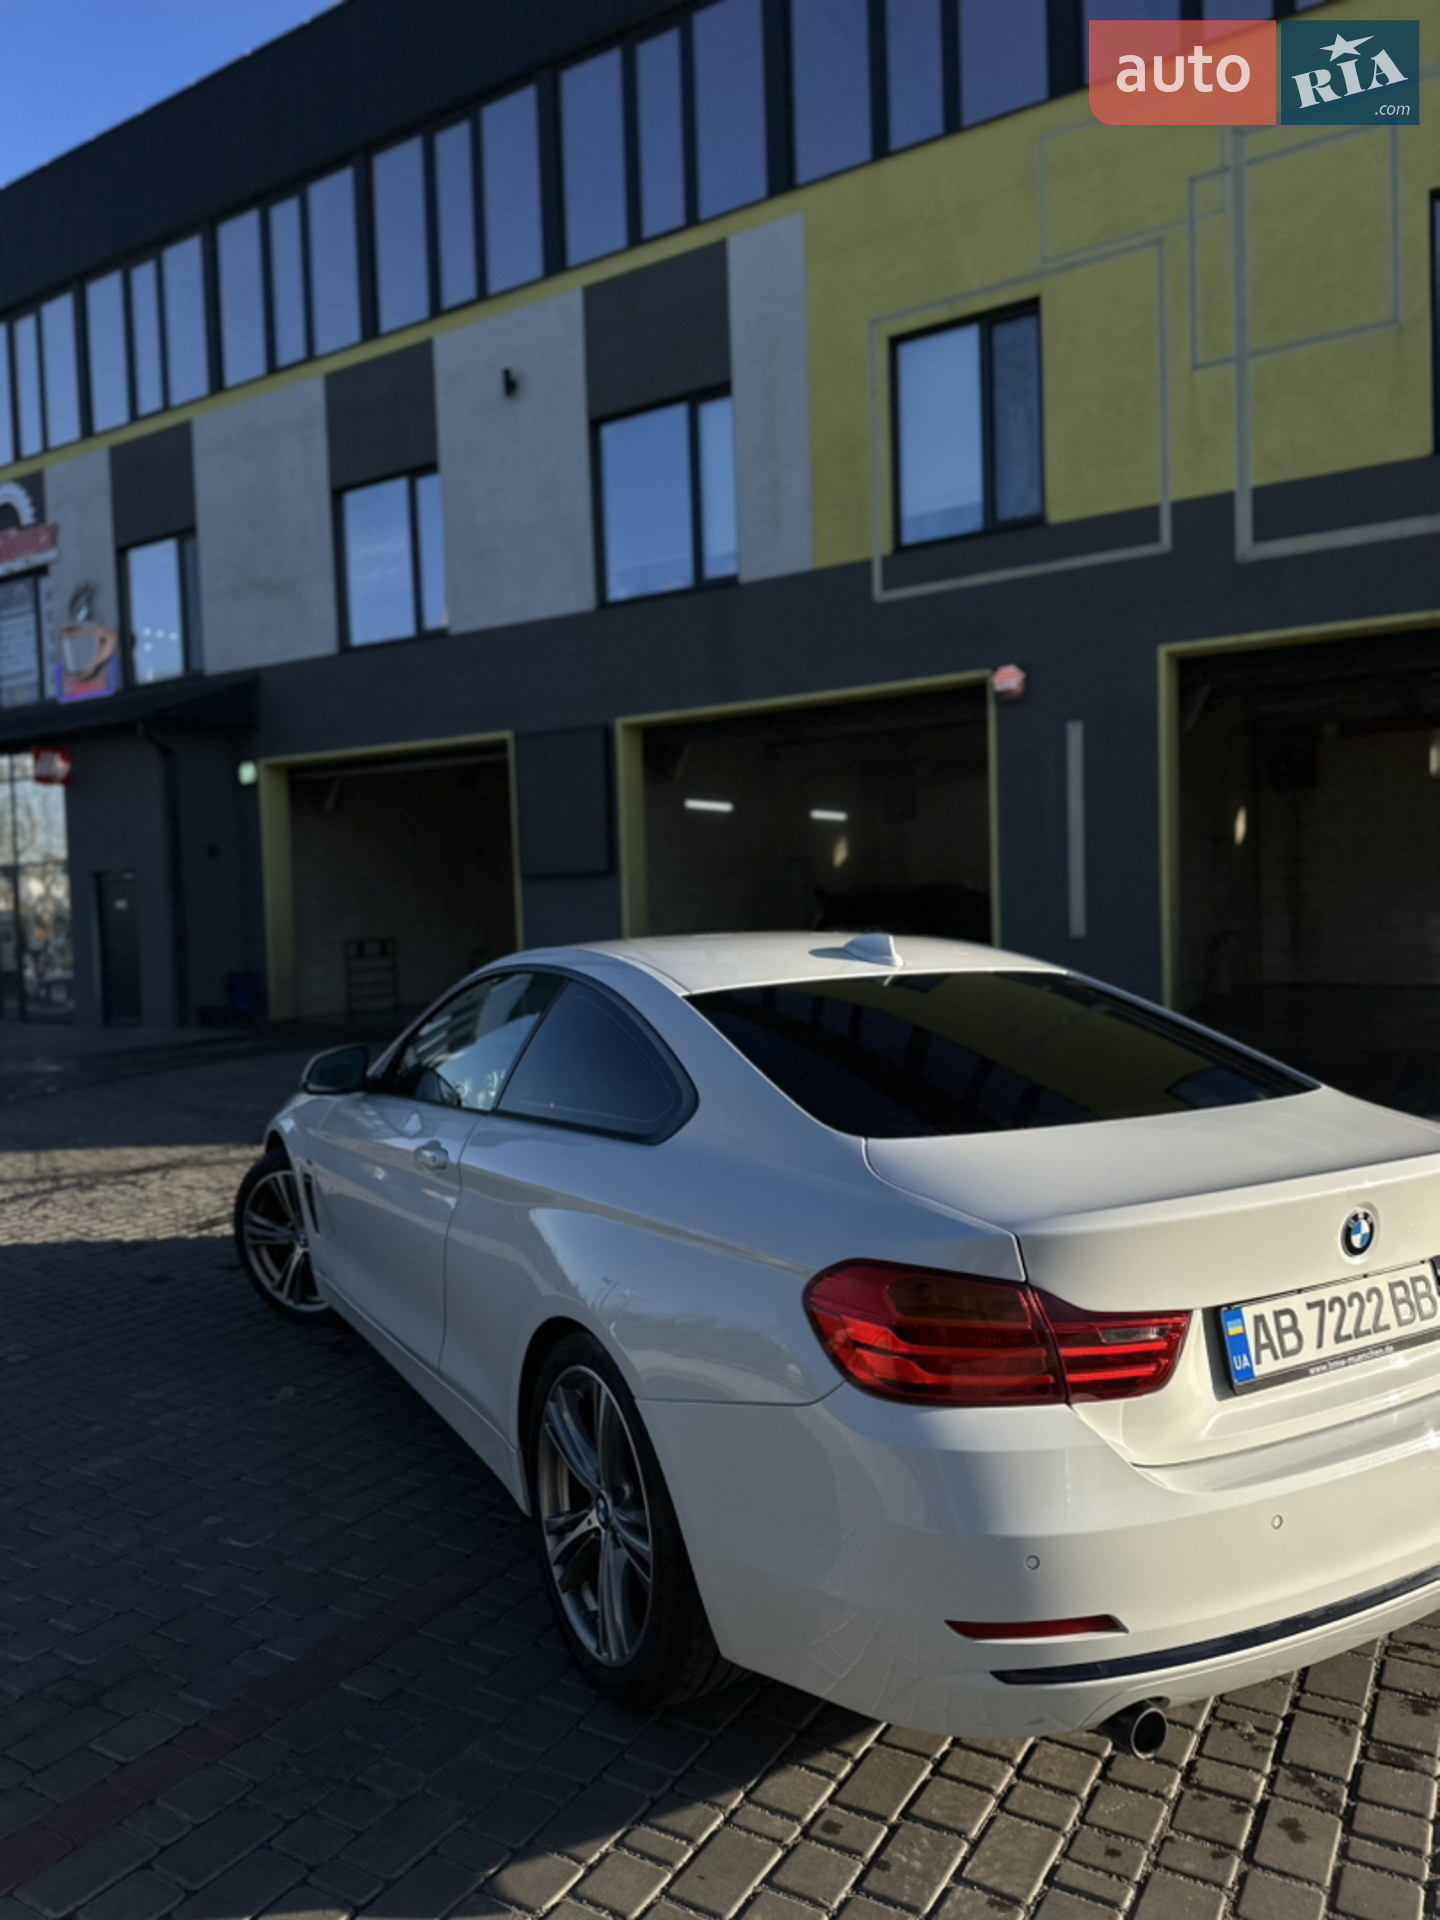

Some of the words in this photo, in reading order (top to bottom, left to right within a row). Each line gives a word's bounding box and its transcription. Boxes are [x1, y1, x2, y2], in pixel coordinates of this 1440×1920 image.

[1253, 1308, 1304, 1365] AB
[1306, 1287, 1391, 1350] 7222
[1388, 1274, 1438, 1327] BB
[1233, 1353, 1251, 1370] UA
